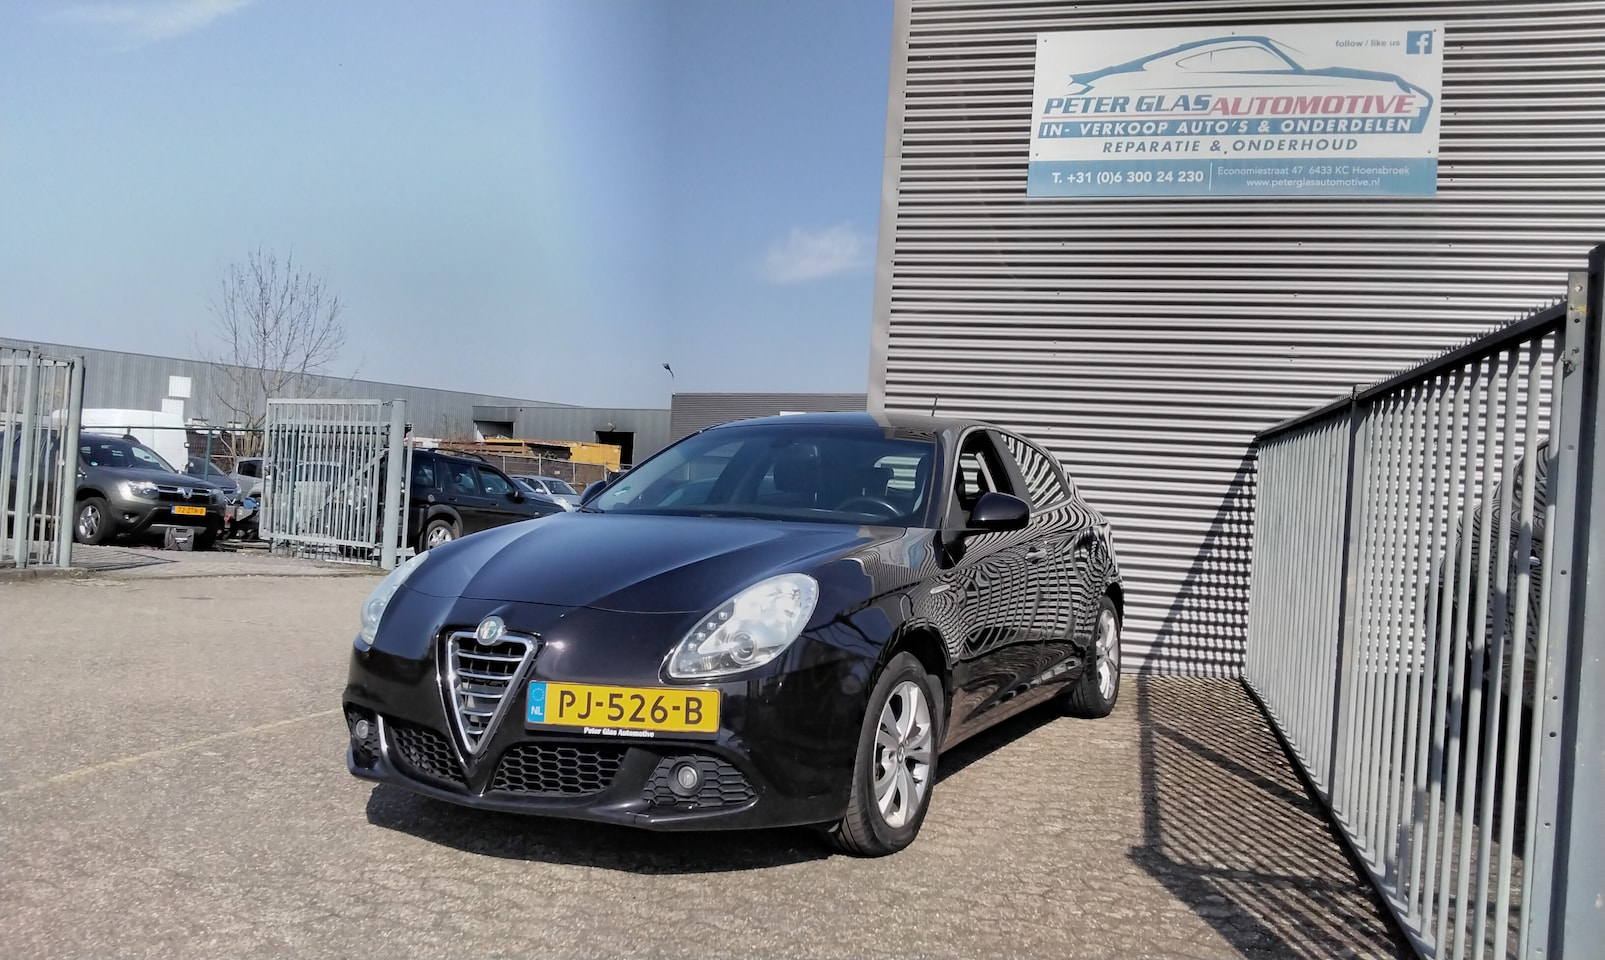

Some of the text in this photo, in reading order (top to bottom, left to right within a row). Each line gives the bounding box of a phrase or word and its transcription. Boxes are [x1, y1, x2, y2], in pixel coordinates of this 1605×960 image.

[1043, 96, 1130, 114] PETER
[1042, 118, 1412, 136] IN- VERKOOP AUTO'S & ONDERDELEN
[1103, 138, 1358, 152] REPARATIE & ONDERHOUD
[1052, 171, 1204, 184] T. +31 (0)6 300 24 230
[1217, 166, 1410, 176] Economiestraat 47 6433 KC Hoensbroek
[1246, 177, 1380, 189] www.peterglasautomotive.nl
[530, 705, 543, 716] NL
[558, 690, 703, 725] PJ-526-B
[583, 727, 602, 735] Peter
[618, 729, 655, 738] Automotive
